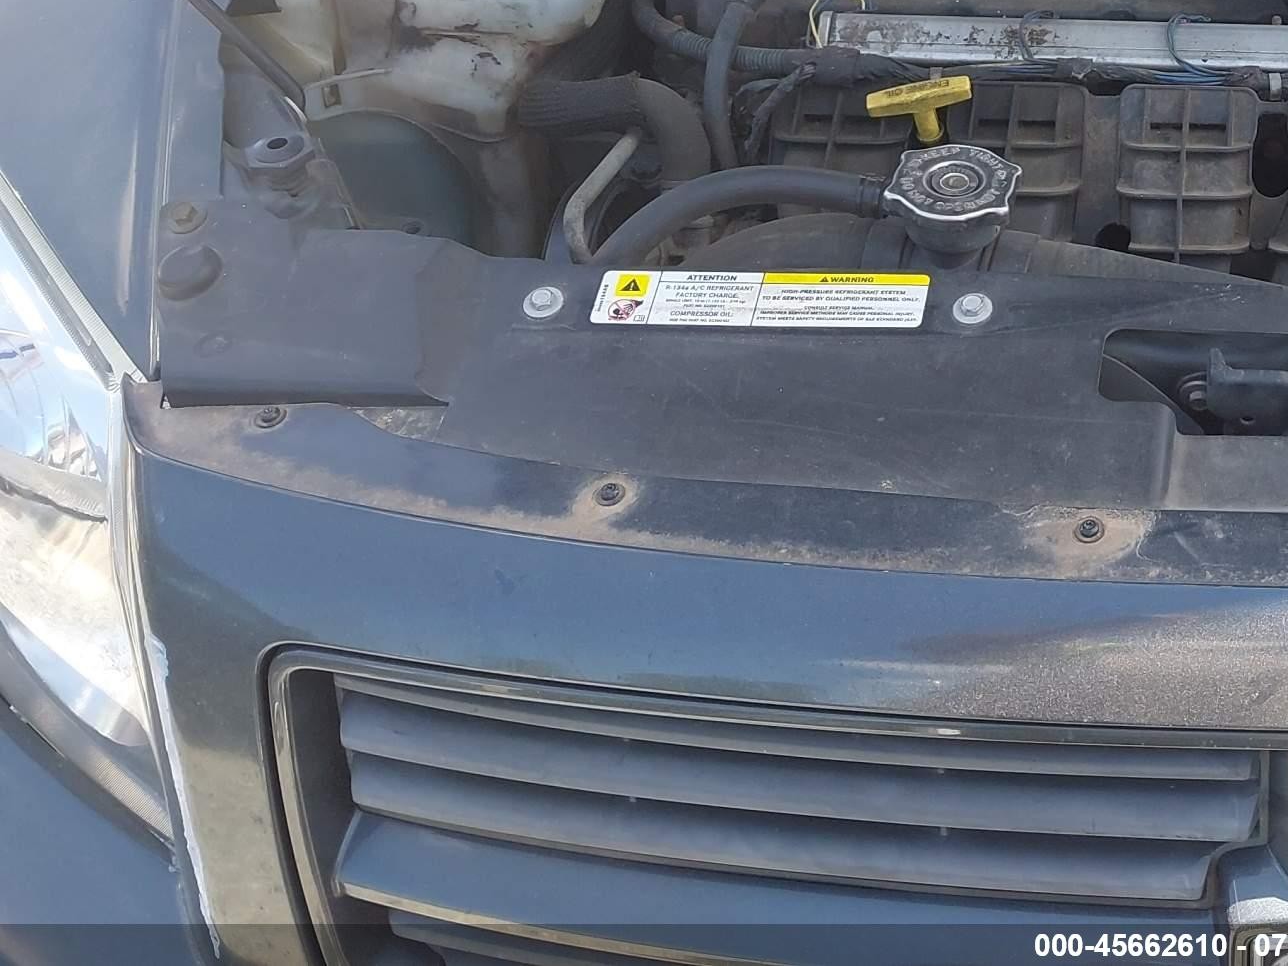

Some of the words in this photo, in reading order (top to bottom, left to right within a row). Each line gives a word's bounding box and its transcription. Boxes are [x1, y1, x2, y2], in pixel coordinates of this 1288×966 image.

[919, 146, 962, 162] KEEP
[968, 148, 1005, 172] TIGHT
[687, 274, 738, 282] ATTENTION
